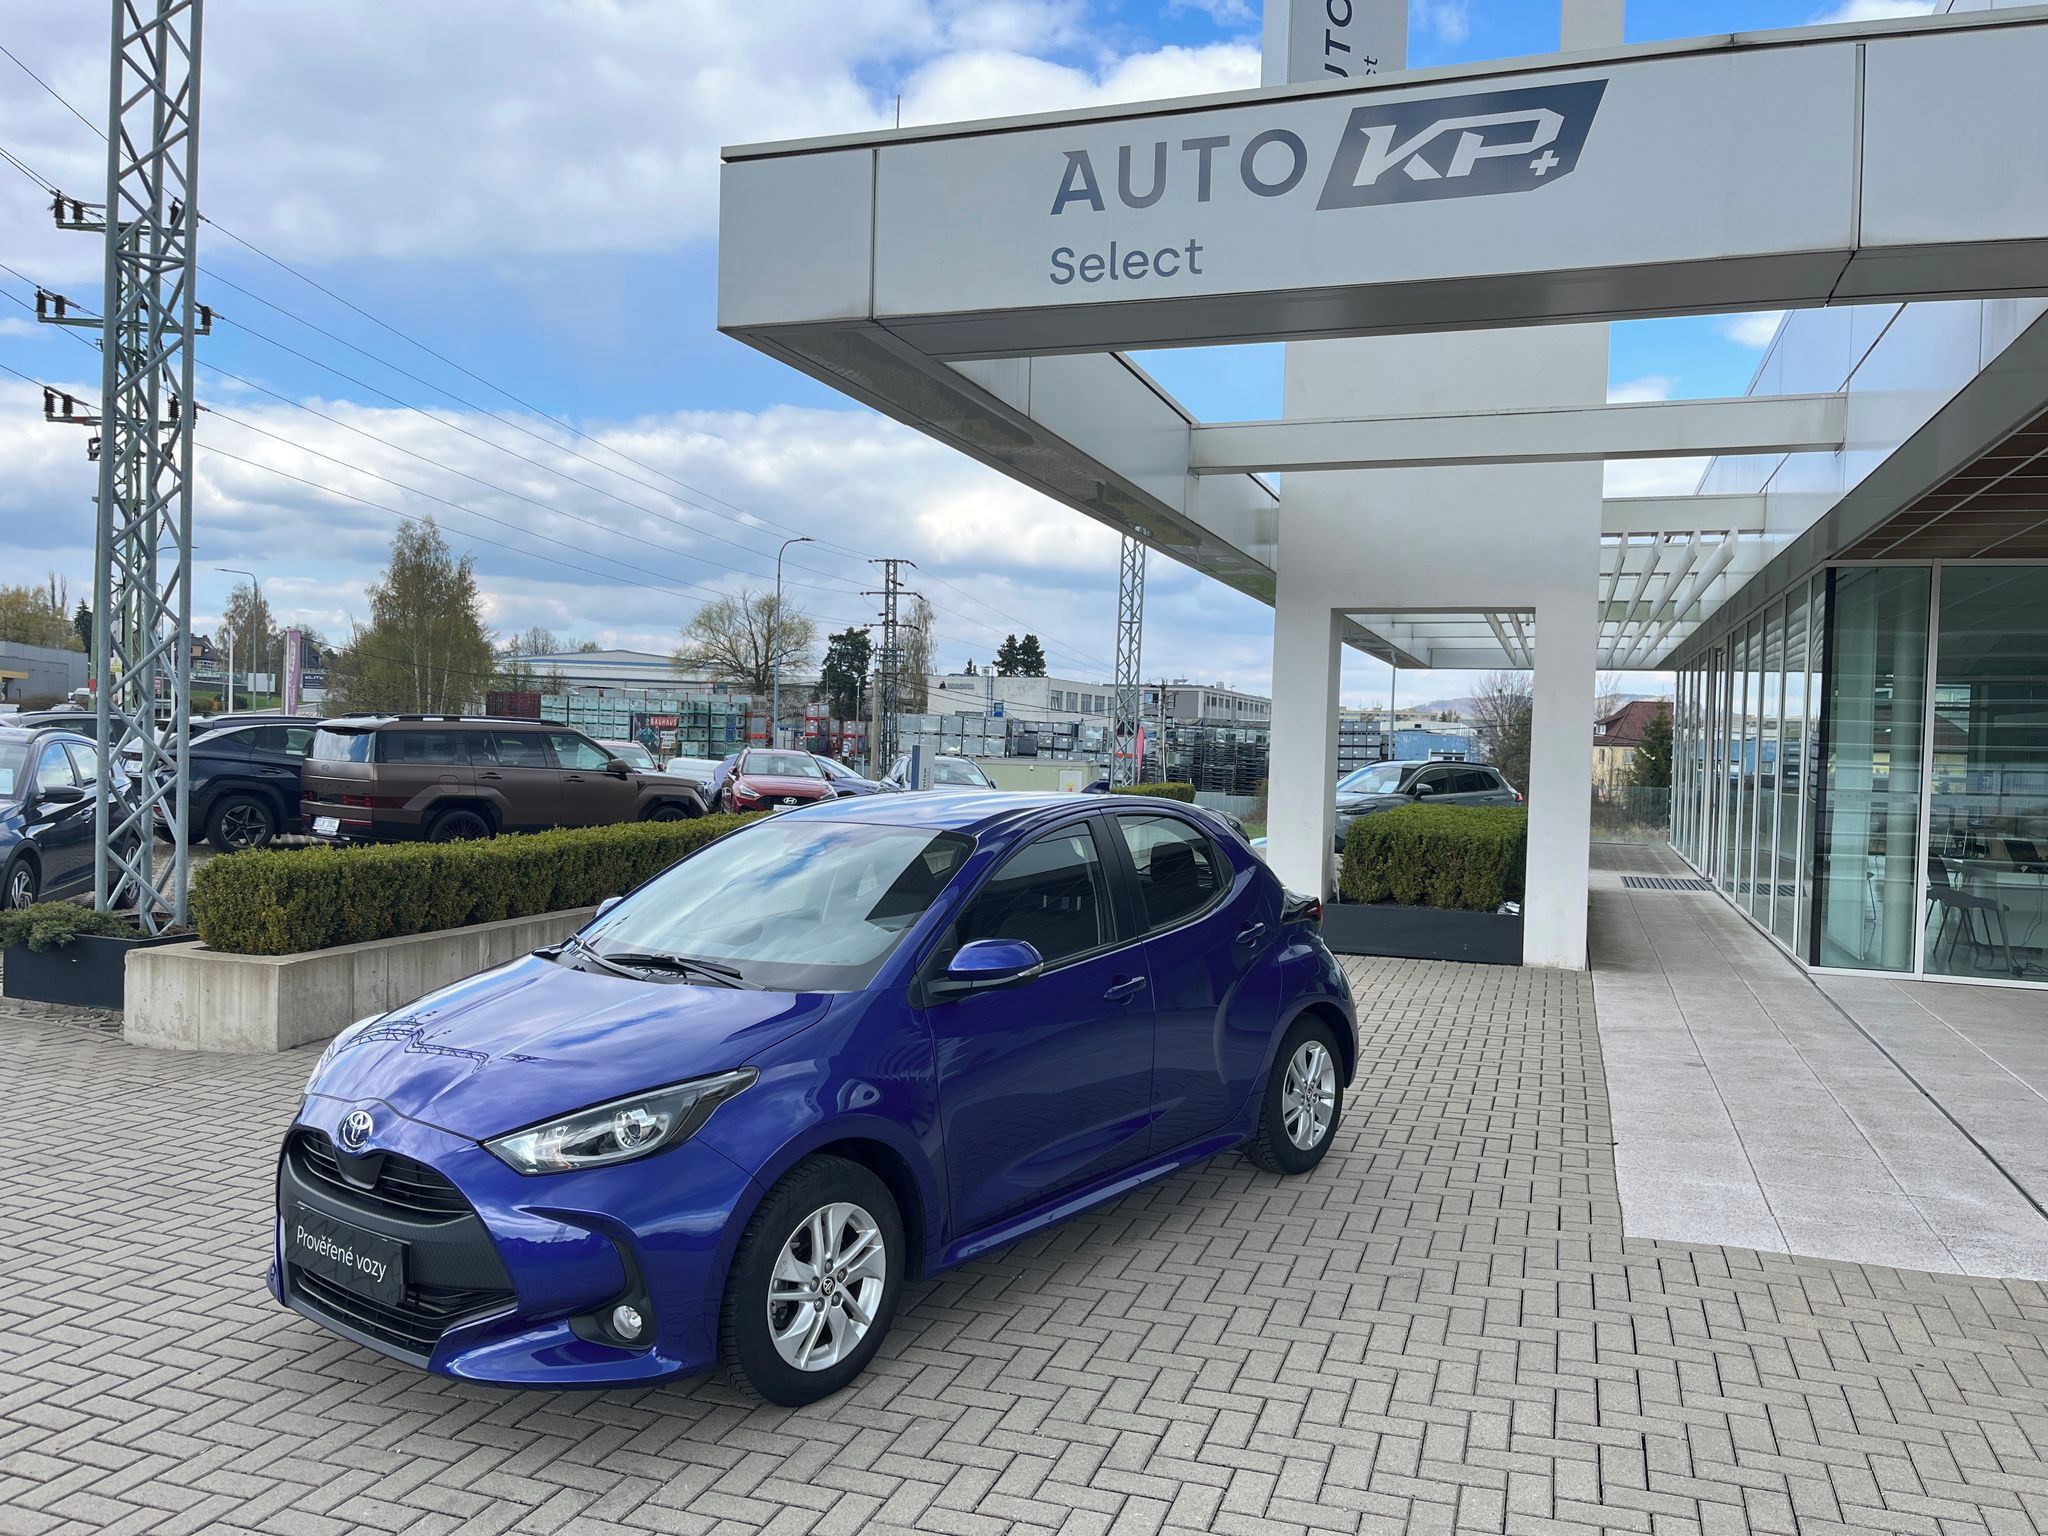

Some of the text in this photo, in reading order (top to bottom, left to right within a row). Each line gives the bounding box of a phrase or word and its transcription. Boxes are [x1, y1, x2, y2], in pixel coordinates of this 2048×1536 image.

[1050, 128, 1308, 215] AUTO
[1050, 239, 1203, 285] Select
[650, 716, 678, 727] BAUHAUS
[296, 1225, 387, 1283] Prověřené vozy
